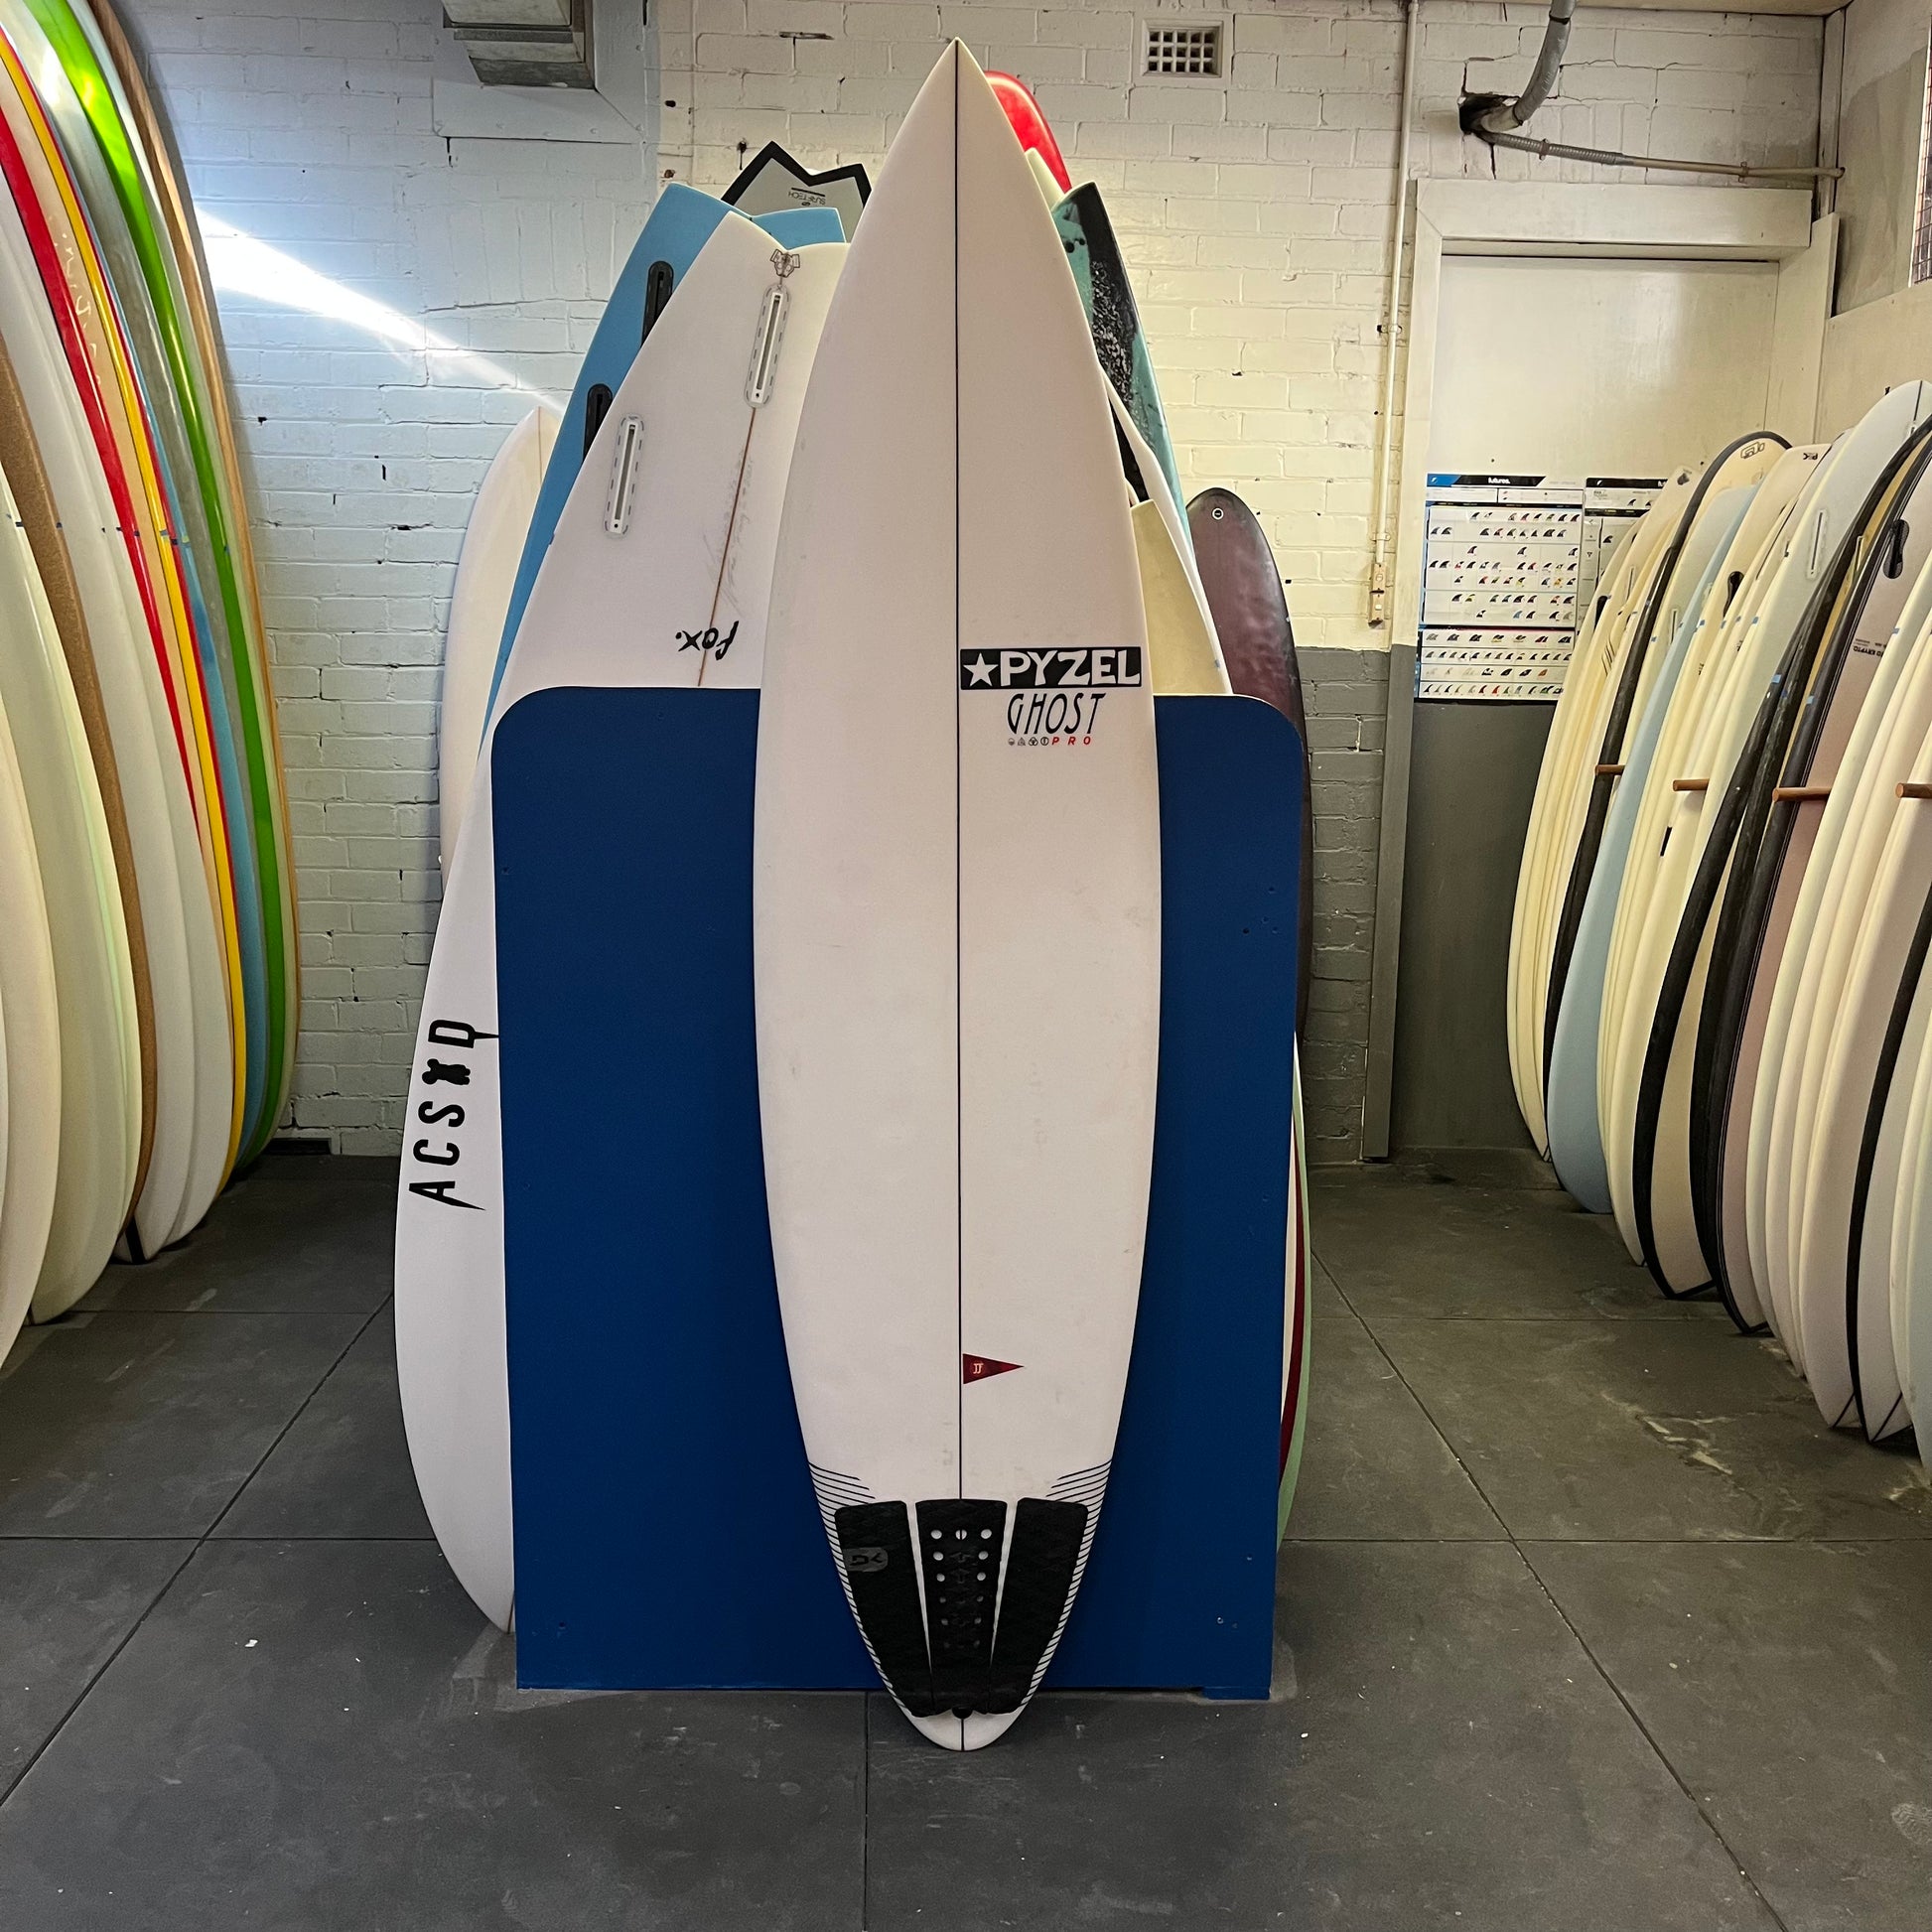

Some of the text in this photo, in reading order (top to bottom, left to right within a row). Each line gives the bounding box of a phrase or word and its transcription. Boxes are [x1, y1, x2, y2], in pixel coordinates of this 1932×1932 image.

[1000, 648, 1141, 687] PYZEL
[1007, 692, 1107, 735] GHOST
[1051, 736, 1092, 746] PRO
